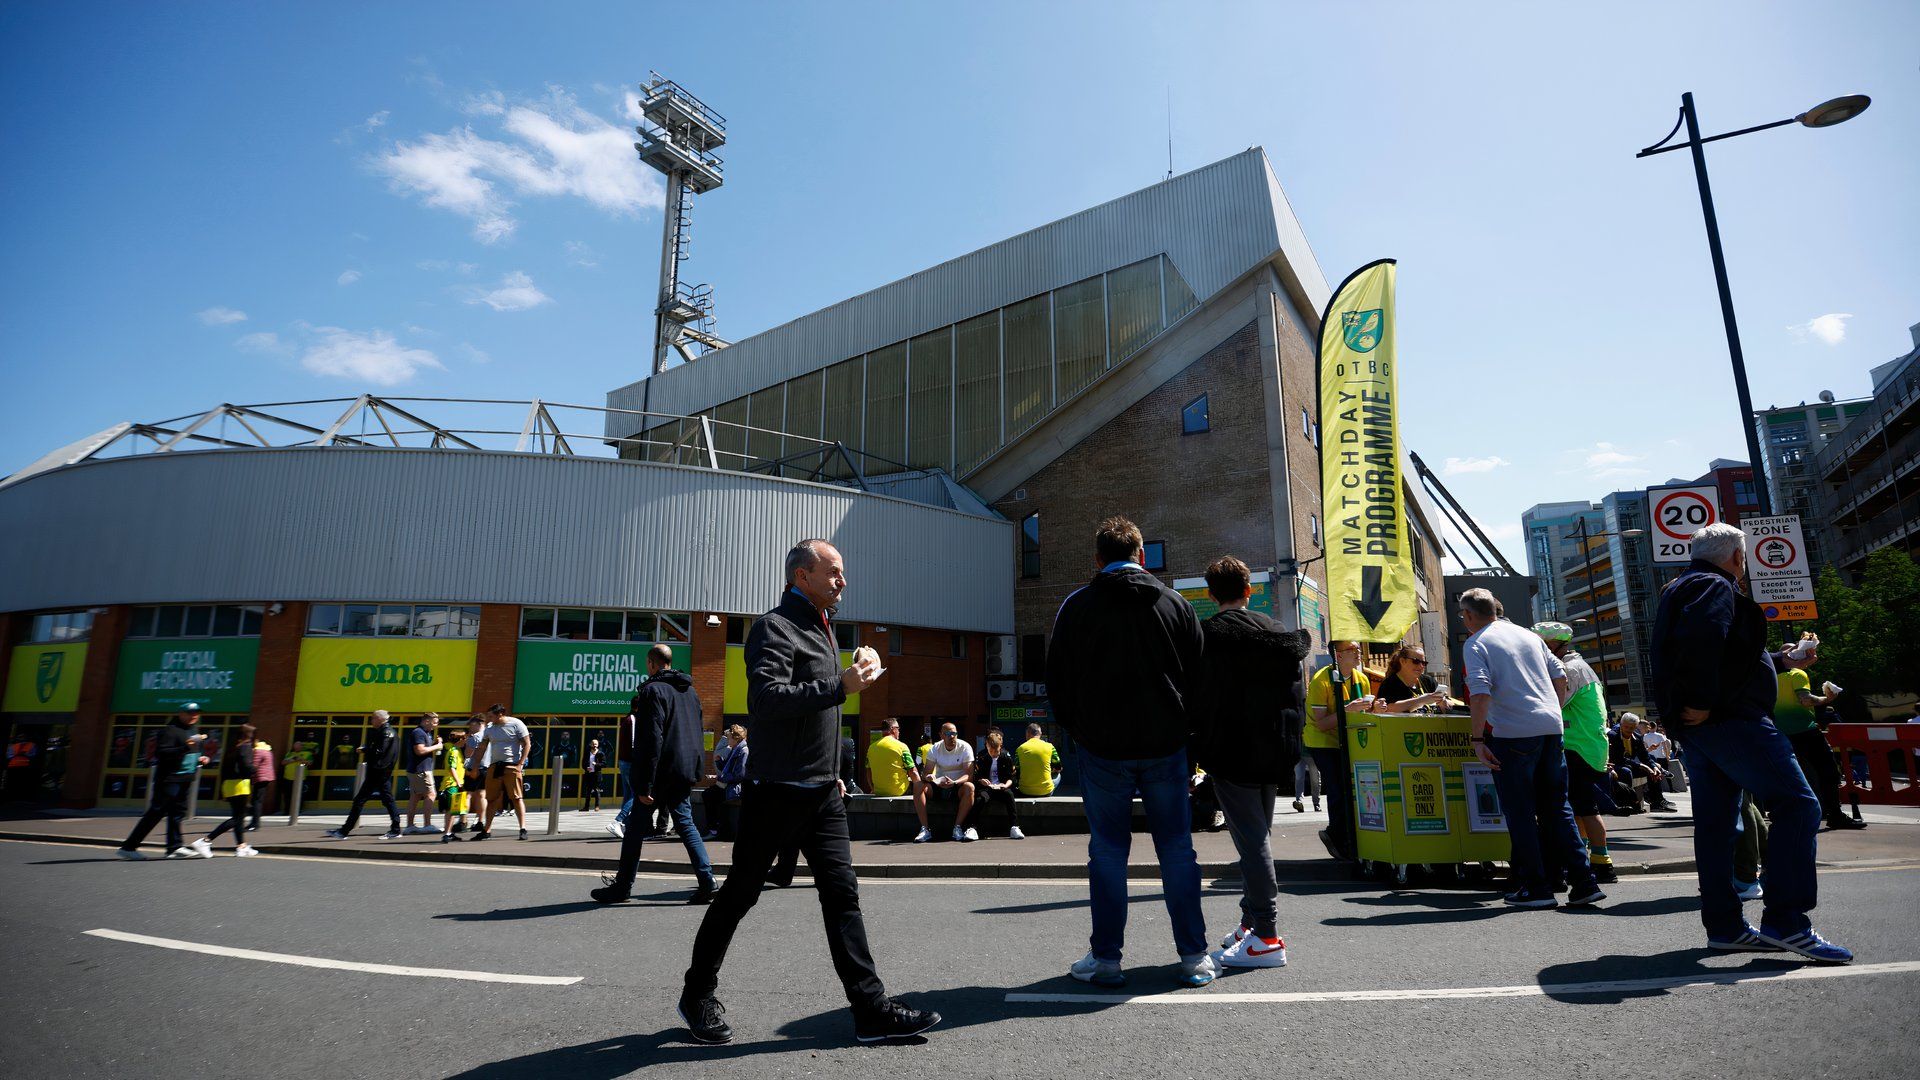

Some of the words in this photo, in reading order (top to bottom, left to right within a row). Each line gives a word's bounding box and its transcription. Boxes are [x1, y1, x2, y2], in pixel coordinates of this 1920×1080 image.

[1339, 391, 1361, 554] MATCHDAY
[1362, 389, 1397, 557] PROGRAMME
[1664, 505, 1707, 526] 20
[1743, 517, 1797, 527] PEDESTRIAN
[1752, 525, 1791, 536] ZONE
[1660, 543, 1692, 556] ZO
[162, 651, 216, 669] OFFICIAL
[572, 653, 638, 672] OFFICIAL
[142, 671, 233, 689] MERCHANDISE
[549, 673, 649, 692] MERCHANDI
[1426, 732, 1471, 747] NORWICH
[1427, 748, 1435, 757] FC
[1436, 748, 1469, 757] MATCHDAY
[1412, 784, 1434, 796] CARD
[1415, 802, 1435, 815] ONLY
